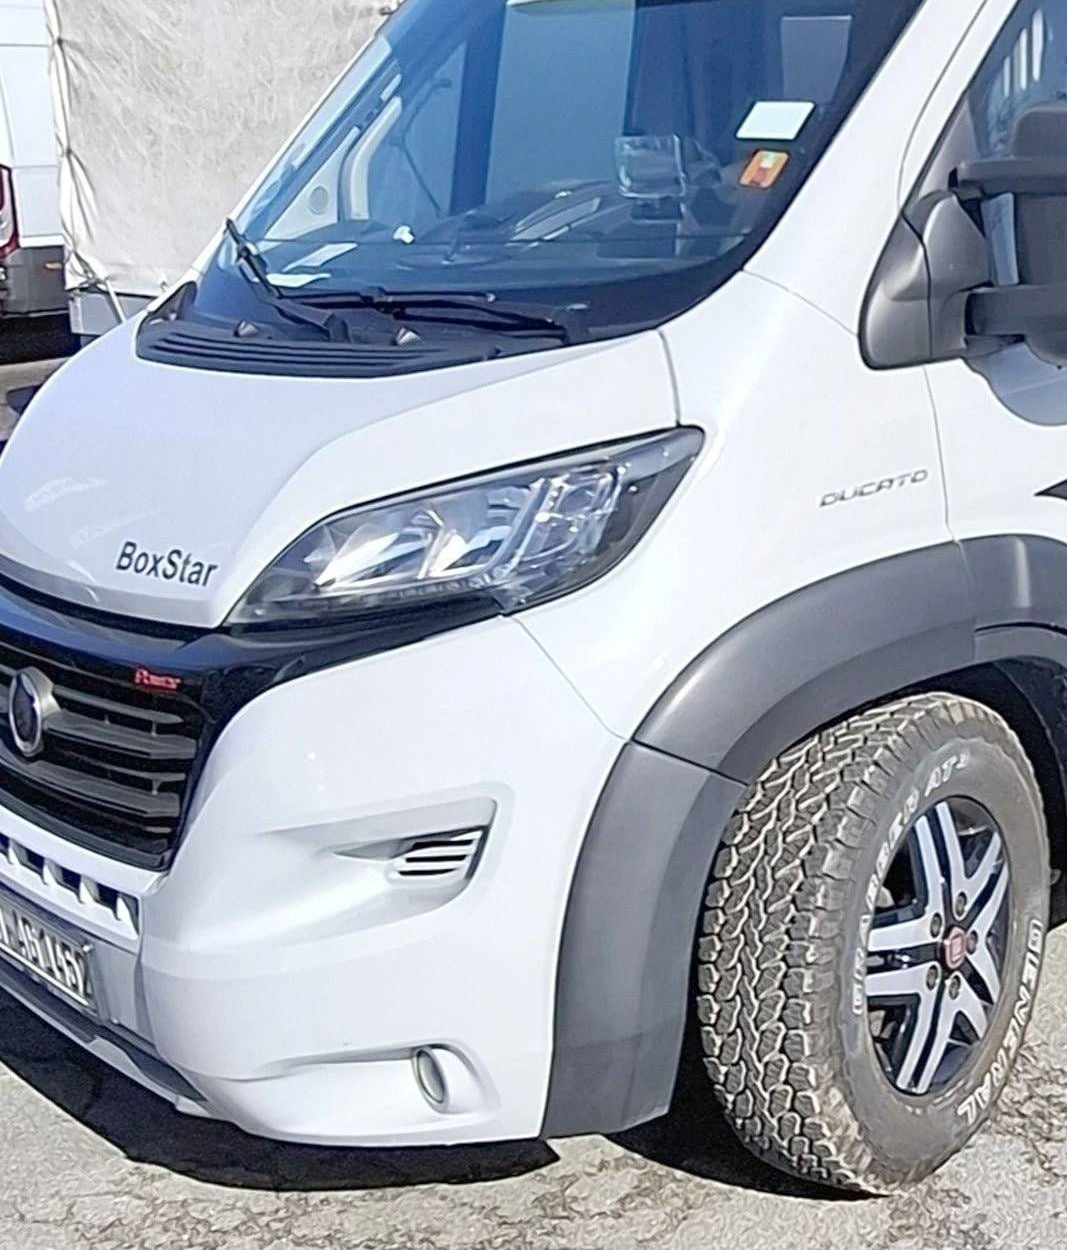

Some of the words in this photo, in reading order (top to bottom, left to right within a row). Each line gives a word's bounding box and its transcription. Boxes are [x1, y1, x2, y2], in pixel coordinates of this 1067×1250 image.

[819, 469, 928, 507] DUCATO
[116, 540, 219, 587] BoxStar
[957, 918, 1043, 1125] GENERAL
